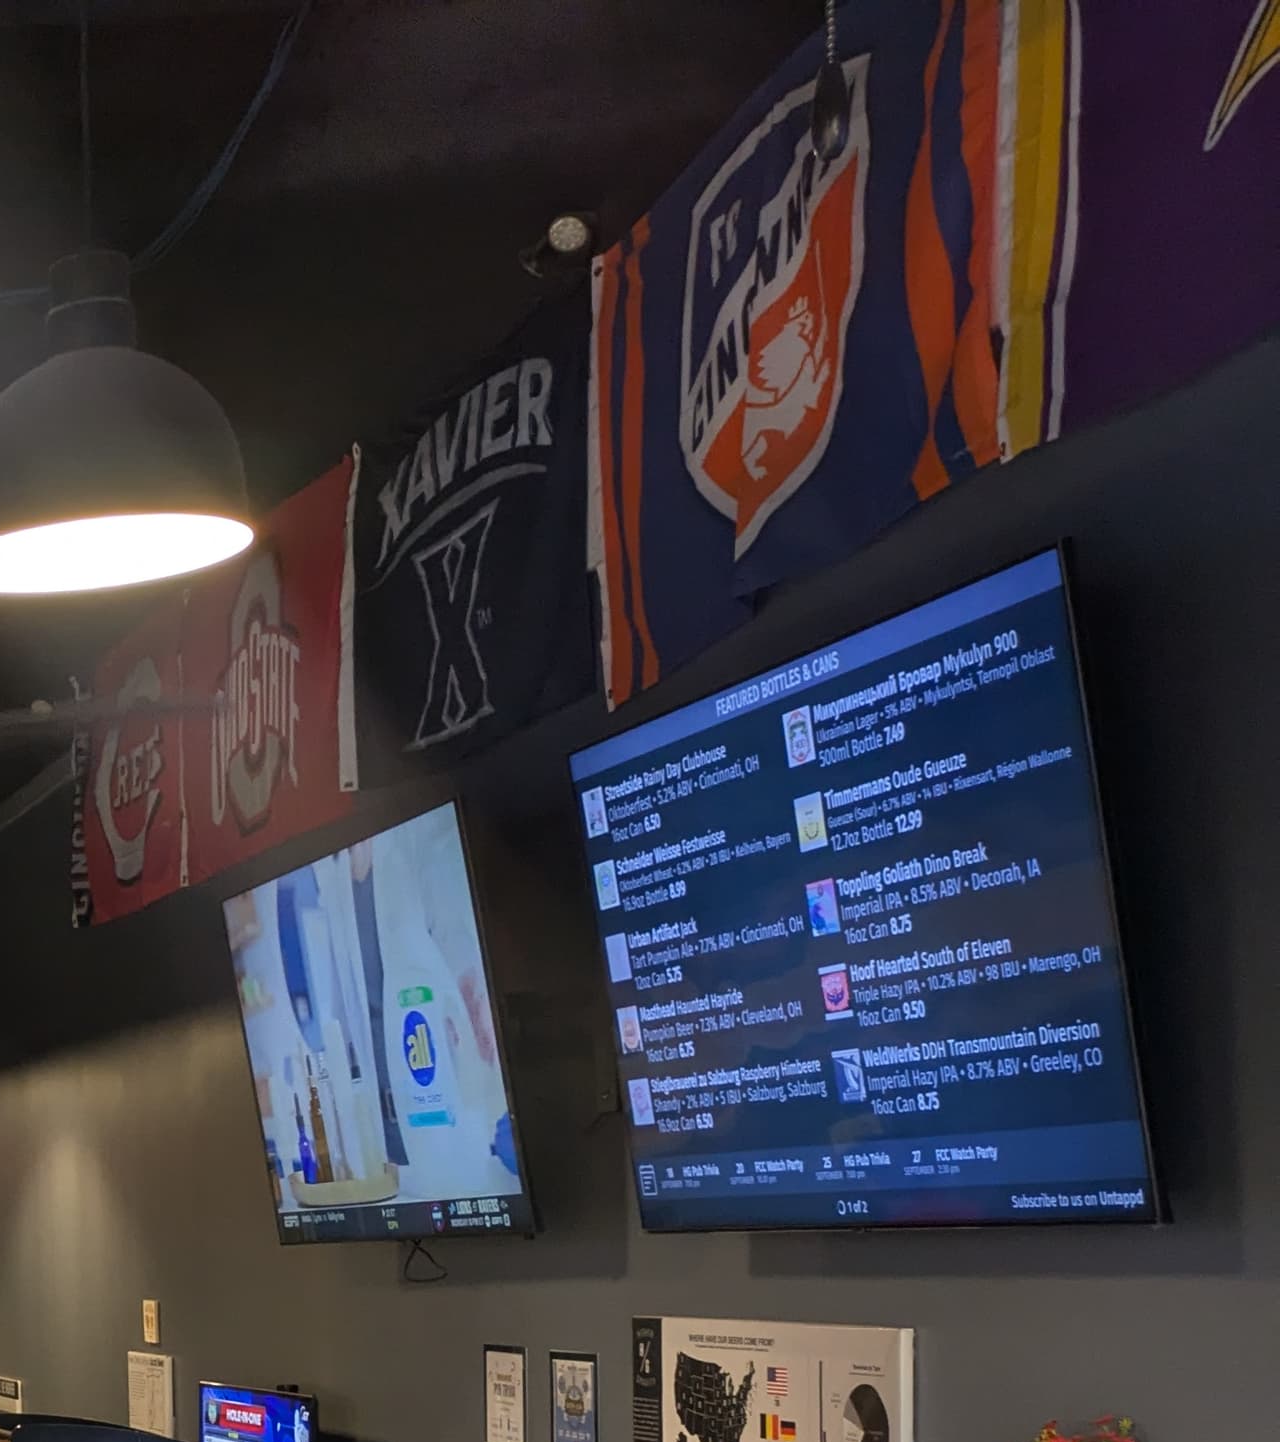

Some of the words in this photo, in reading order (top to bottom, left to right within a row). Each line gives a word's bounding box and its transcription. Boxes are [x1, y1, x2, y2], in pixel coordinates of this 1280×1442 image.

[376, 357, 553, 569] XAVIER
[715, 684, 760, 716] FEATURED
[760, 666, 800, 698] BOTTLES
[801, 663, 812, 681] &
[813, 650, 839, 676] CANS
[897, 661, 941, 693] Бровар
[942, 642, 992, 675] Mykulyn
[993, 629, 1018, 655] 900
[818, 741, 850, 767] 500ml
[850, 731, 883, 756] Bottle
[883, 721, 905, 745] 7.49
[823, 776, 891, 809] Timmermans
[891, 764, 922, 788] Oude
[923, 752, 966, 778] Gueuze
[830, 830, 860, 851] 12.7oz
[860, 819, 893, 843] Bottle
[894, 809, 922, 833] 12.99
[836, 871, 883, 898] Toppling
[882, 858, 923, 885] Goliath
[923, 853, 951, 875] Dino
[951, 842, 988, 867] Break
[840, 894, 883, 921] Imperial
[884, 891, 902, 910] IPA
[909, 882, 937, 904] 8.5%
[939, 876, 961, 898] ABV
[970, 861, 1025, 890] Decorah,
[1026, 858, 1041, 877] IA
[844, 927, 868, 944] 16oz
[867, 922, 889, 939] Can
[889, 913, 912, 935] 8.75
[849, 959, 875, 982] Hoof
[875, 951, 920, 977] Hearted
[920, 946, 955, 969] South
[955, 941, 969, 962] of
[970, 938, 1011, 959] Eleven
[852, 986, 879, 1004] Triple
[879, 983, 903, 1000] Hazy
[903, 978, 920, 994] IPA
[926, 971, 955, 990] 10.2%
[957, 967, 976, 985] ABV
[984, 964, 999, 981] 98
[999, 960, 1020, 978] IBU
[1027, 952, 1081, 973] Marengo,
[1081, 945, 1101, 963] OH
[856, 1010, 881, 1026] 16oz
[880, 1006, 902, 1023] Can
[902, 999, 925, 1020] 9.50
[407, 1023, 434, 1071] all
[862, 1042, 920, 1067] WeldWerks
[920, 1040, 946, 1060] DDH
[946, 1026, 1036, 1056] Transmountain
[1038, 1018, 1100, 1045] Diversion
[866, 1069, 910, 1092] Imperial
[911, 1069, 938, 1088] Hazy
[939, 1064, 959, 1083] IPA
[966, 1060, 995, 1080] 8.7%
[997, 1057, 1019, 1076] ABV
[1029, 1050, 1082, 1073] Greeley,
[1083, 1047, 1102, 1066] CO
[870, 1098, 895, 1114] 16oz
[895, 1096, 916, 1113] Can
[916, 1091, 940, 1110] 8.75
[1010, 1193, 1056, 1208] Subscribe
[1057, 1193, 1069, 1207] to
[1069, 1195, 1083, 1206] us
[1084, 1194, 1098, 1206] on
[1098, 1189, 1144, 1208] Untappd
